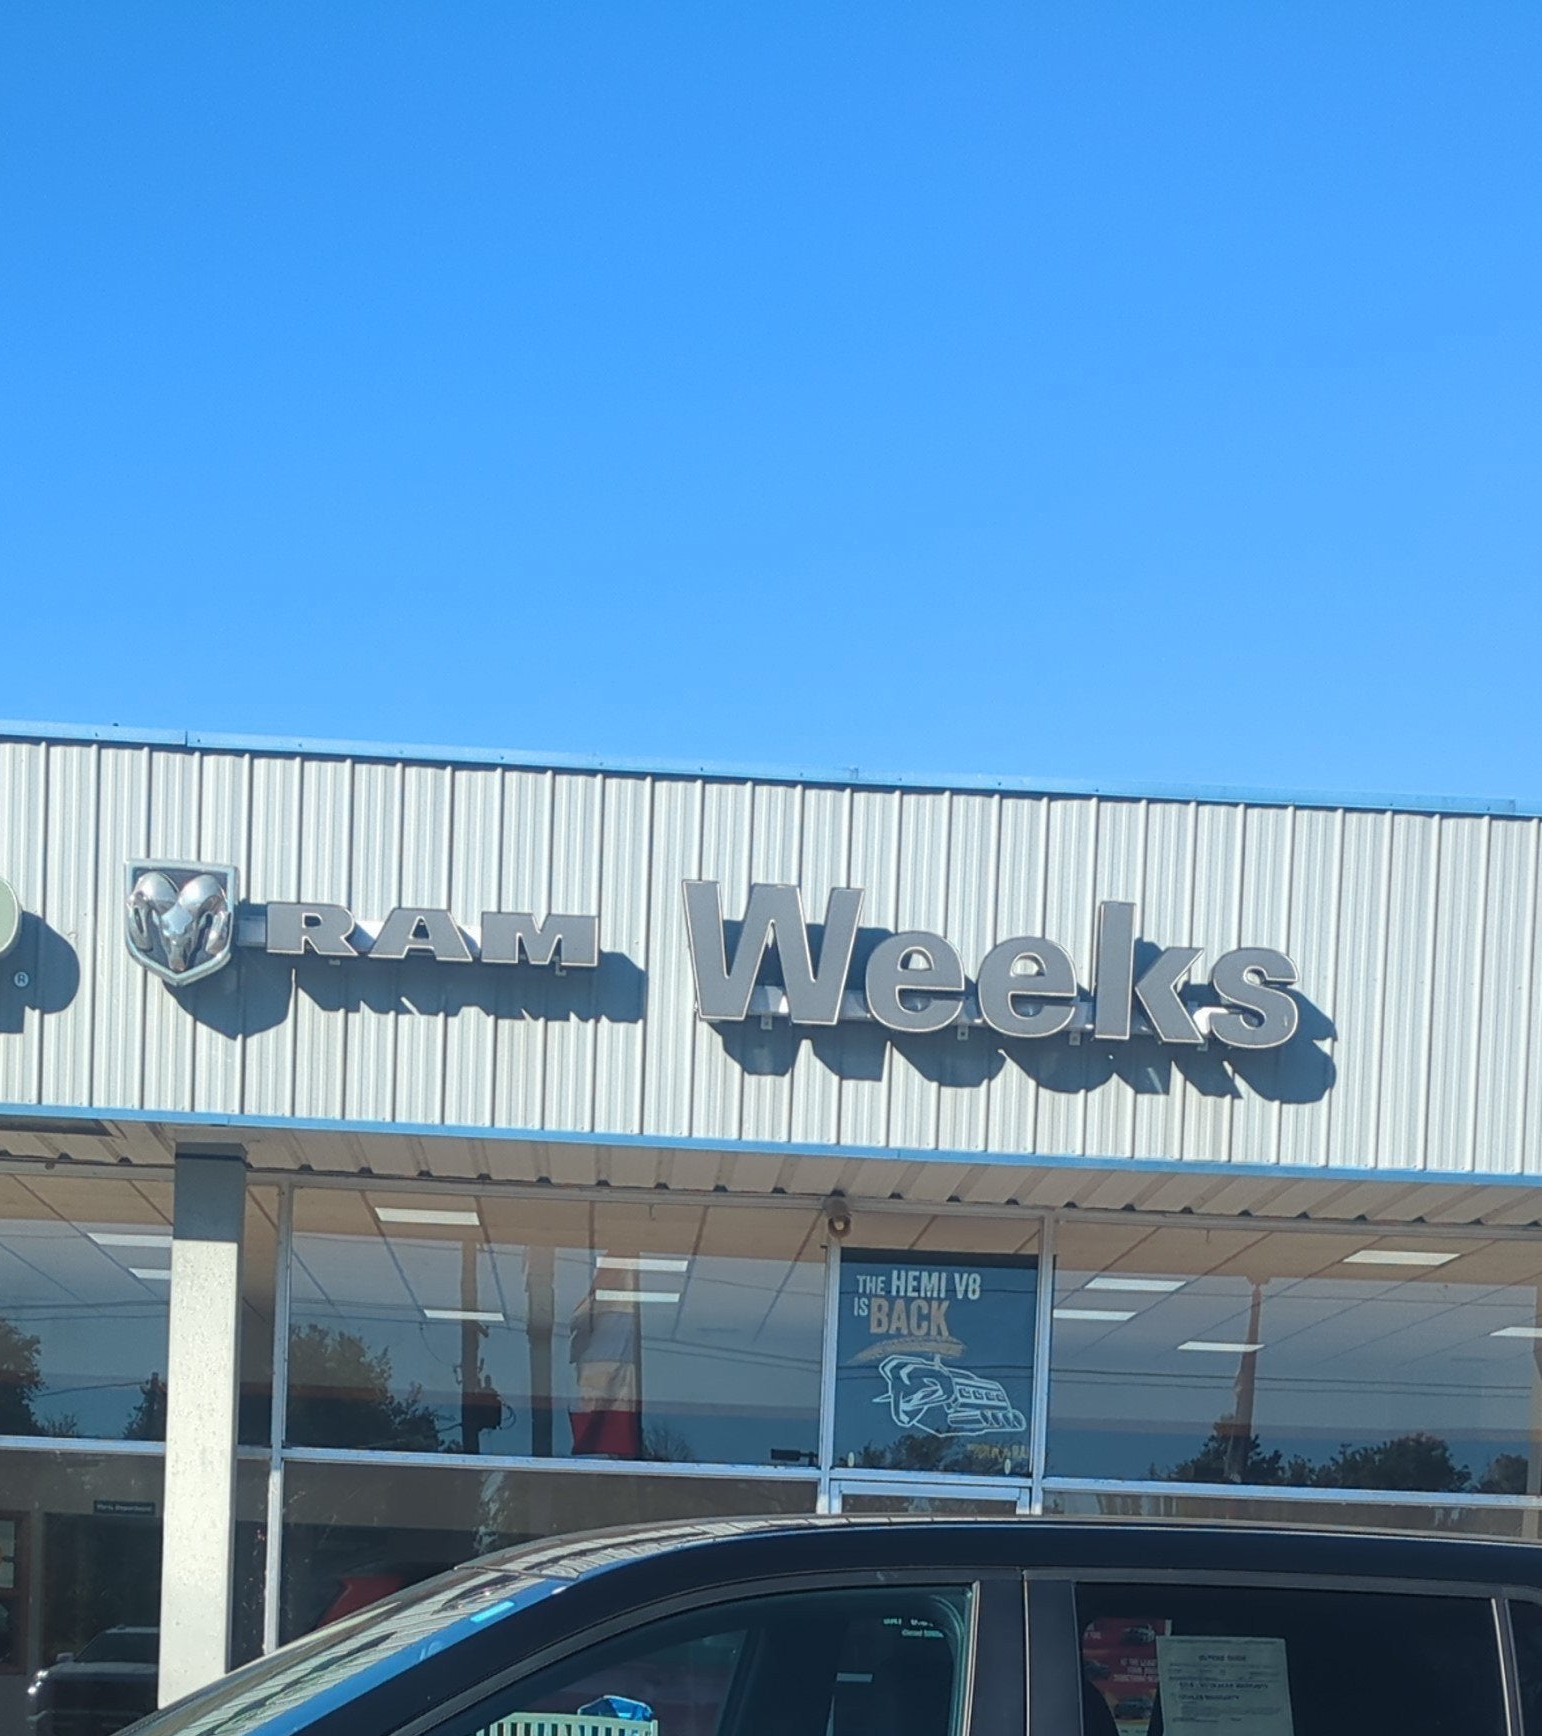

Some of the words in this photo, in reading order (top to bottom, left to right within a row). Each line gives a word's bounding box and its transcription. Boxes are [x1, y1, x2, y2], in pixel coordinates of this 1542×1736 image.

[265, 901, 601, 967] RAM
[681, 879, 1300, 1049] Weeks
[857, 1275, 886, 1295] THE
[891, 1270, 947, 1299] HEMI
[954, 1273, 982, 1300] V8
[854, 1298, 869, 1316] IS
[869, 1298, 950, 1336] BACK
